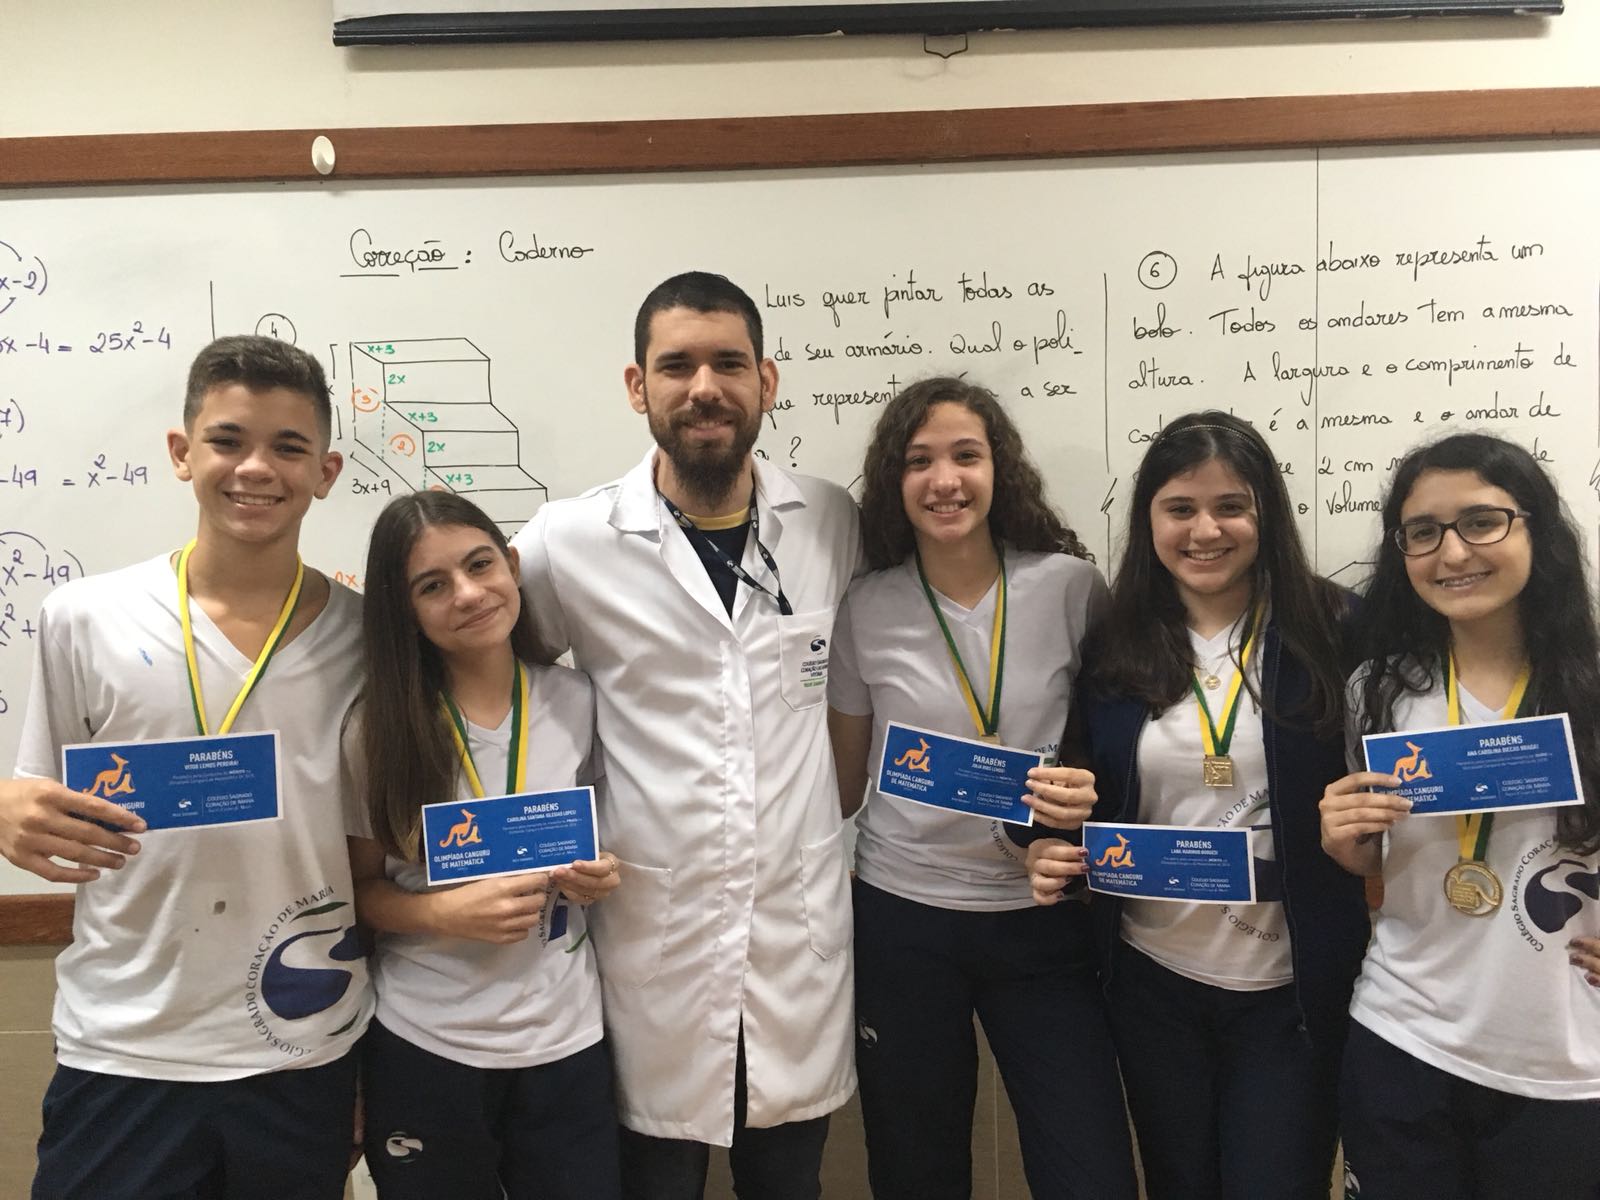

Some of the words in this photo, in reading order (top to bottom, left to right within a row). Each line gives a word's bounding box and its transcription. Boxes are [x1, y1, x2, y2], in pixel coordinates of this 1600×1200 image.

[350, 229, 446, 272] Correção
[1149, 261, 1161, 279] 6
[1211, 253, 1226, 281] A
[1316, 241, 1381, 272] abaixo
[1395, 235, 1499, 282] representa
[1511, 242, 1544, 260] um
[822, 290, 870, 328] quer
[884, 270, 943, 319] pintar
[1027, 282, 1055, 296] as
[1209, 306, 1276, 336] Todos
[1299, 316, 1318, 331] os
[1327, 300, 1408, 329] andares
[774, 336, 793, 361] de
[950, 320, 1002, 354] Qual
[1012, 339, 1028, 351] o
[1243, 363, 1257, 384] A
[1273, 351, 1350, 405] largura
[1362, 365, 1373, 376] e
[1386, 363, 1398, 374] o
[1554, 342, 1578, 368] de
[813, 374, 902, 425] represent
[1020, 384, 1035, 398] a
[1269, 407, 1283, 432] é
[1296, 420, 1310, 431] a
[1321, 414, 1393, 430] mesma
[1413, 414, 1424, 424] e
[1441, 411, 1454, 422] o
[1465, 391, 1520, 420] andar
[1529, 391, 1561, 418] de
[1317, 455, 1335, 475] 2
[1344, 460, 1374, 473] cm
[1479, 734, 1523, 748] PARABÉNS
[189, 749, 234, 763] PARABÉNS
[973, 754, 1006, 768] PARABÉNS
[524, 802, 559, 815] PARABÉNS
[434, 852, 464, 863] OLIMPÍADA
[464, 849, 491, 859] CANGURU
[1176, 840, 1212, 849] PARABÉNS
[449, 857, 485, 868] MATEMÁTICA
[247, 924, 279, 990] CORAÇÃO
[277, 905, 294, 924] DE
[296, 885, 334, 909] MARIA
